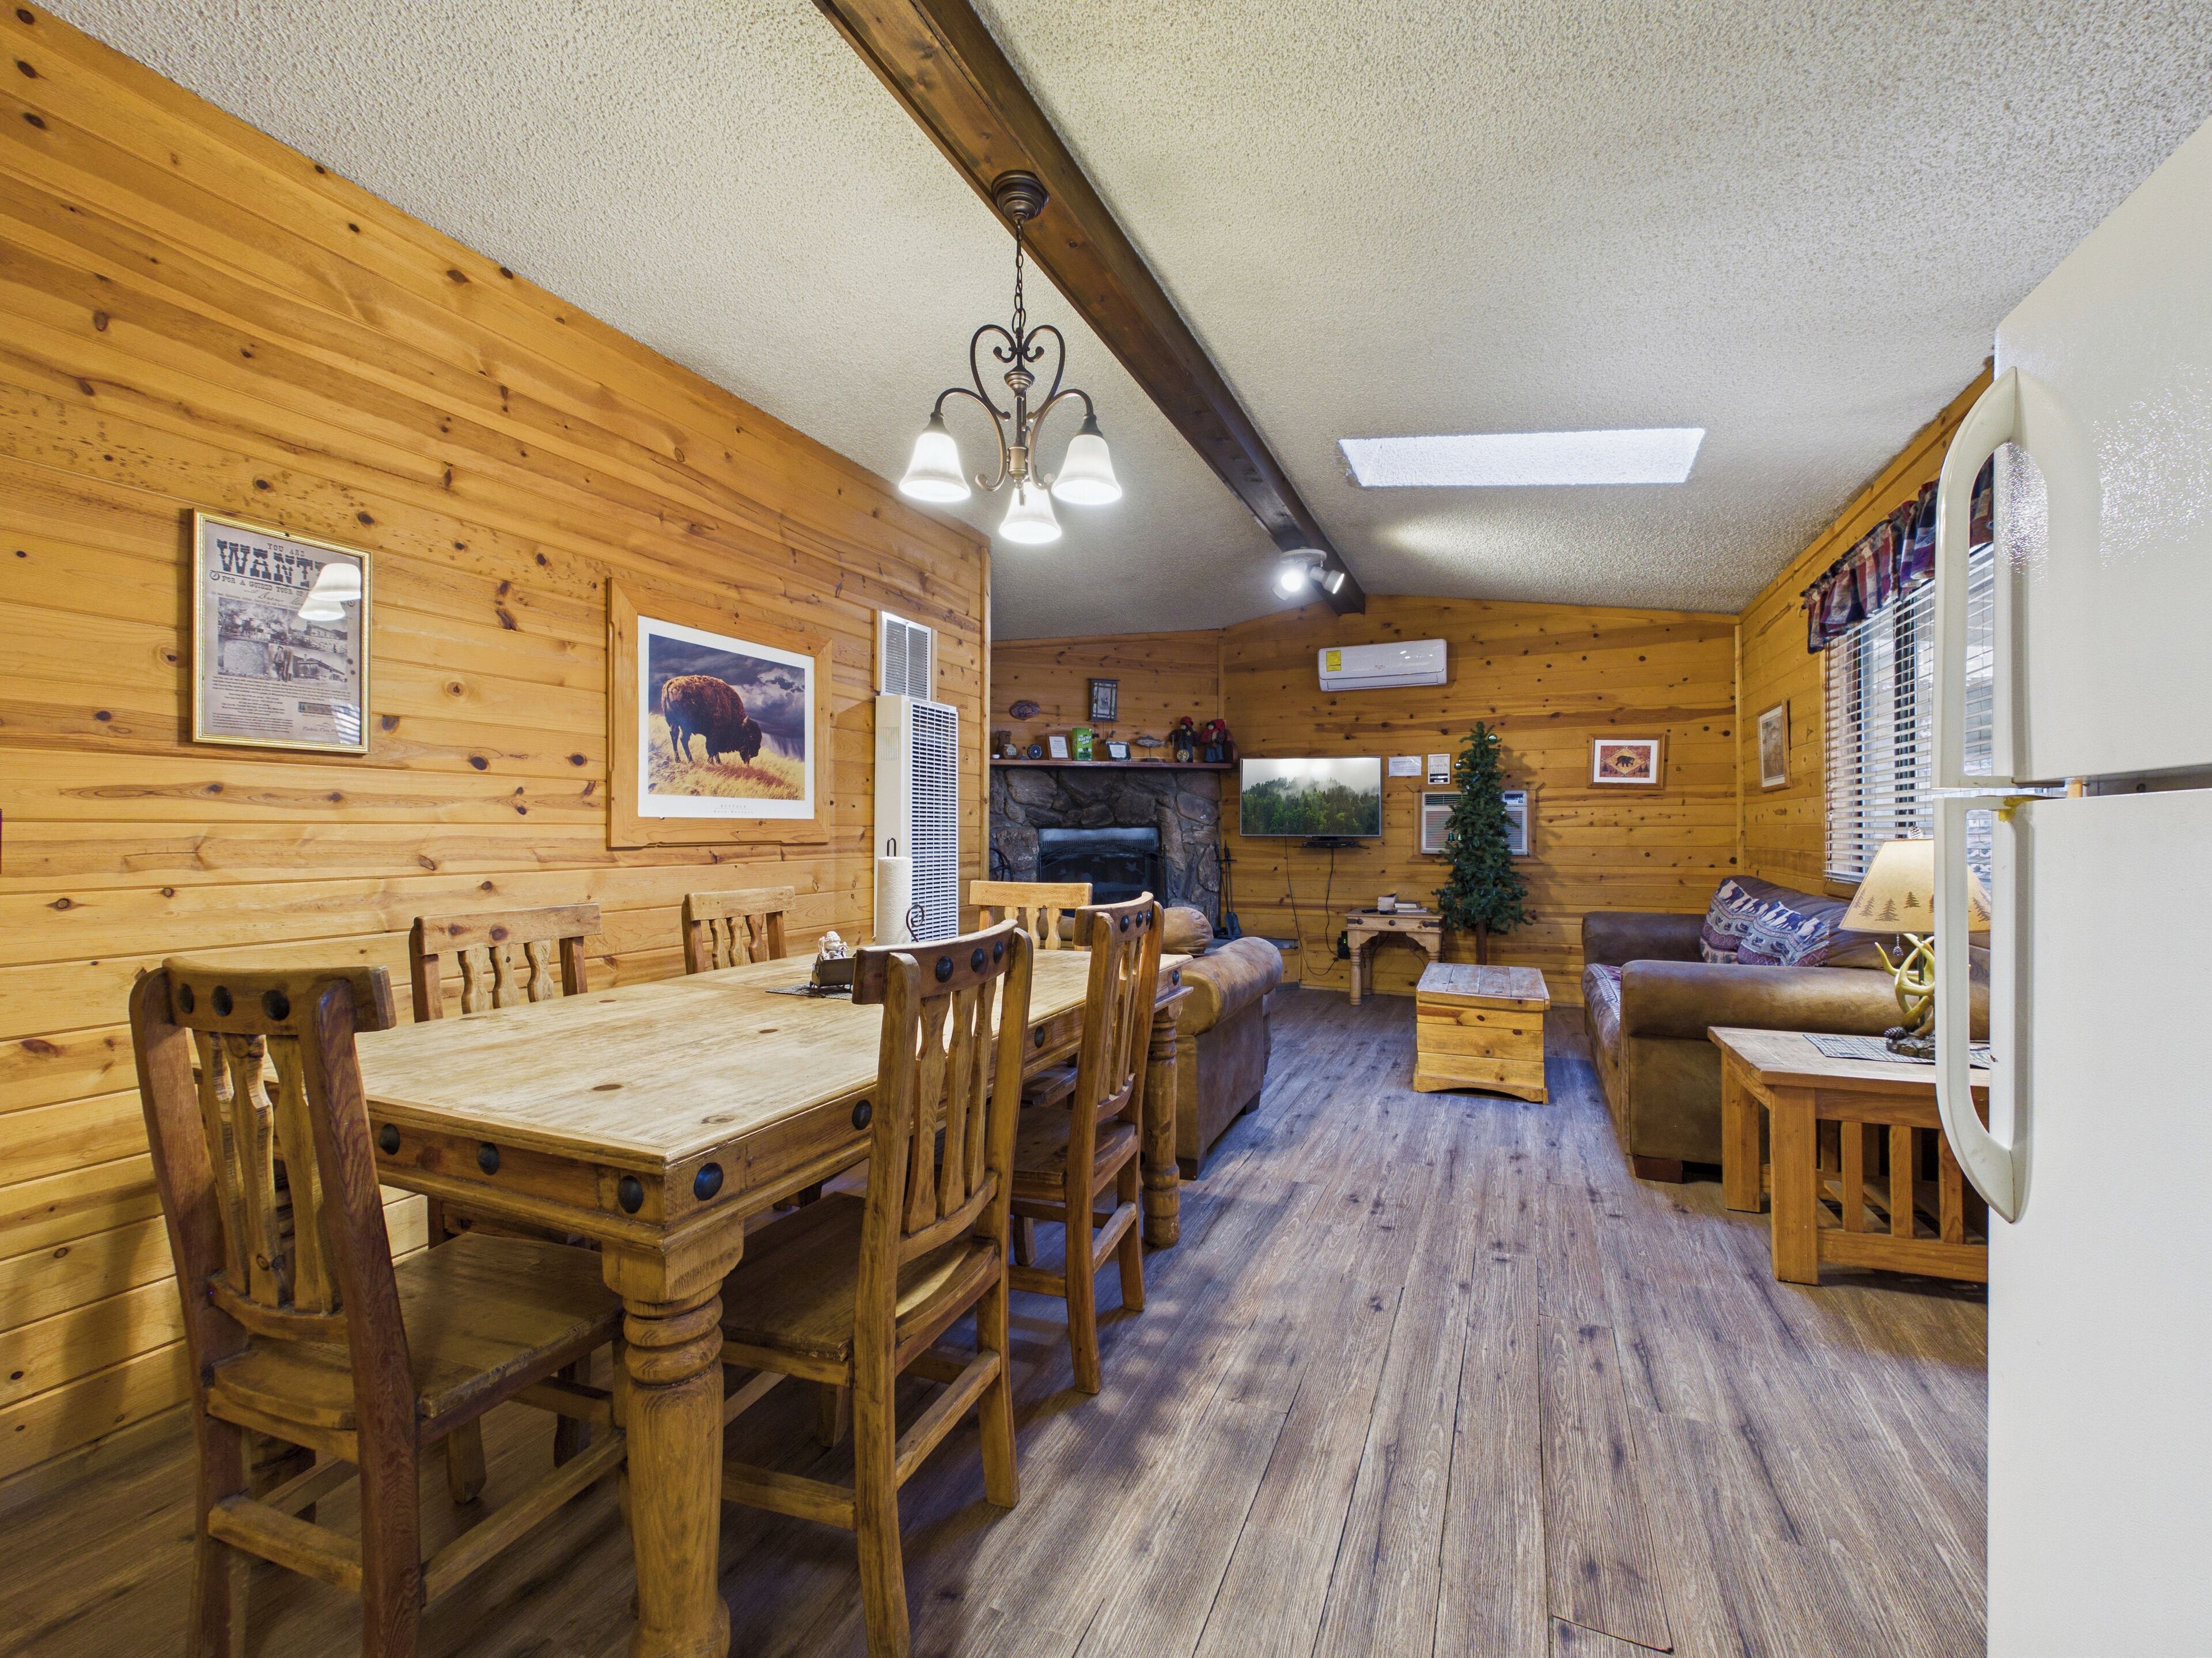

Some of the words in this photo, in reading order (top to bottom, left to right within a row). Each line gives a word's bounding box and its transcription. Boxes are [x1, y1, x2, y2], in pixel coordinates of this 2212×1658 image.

[267, 542, 284, 552] YOU
[289, 548, 305, 557] ARE
[221, 575, 236, 584] FOR
[249, 581, 273, 591] GUIDED
[276, 586, 293, 595] TOUR
